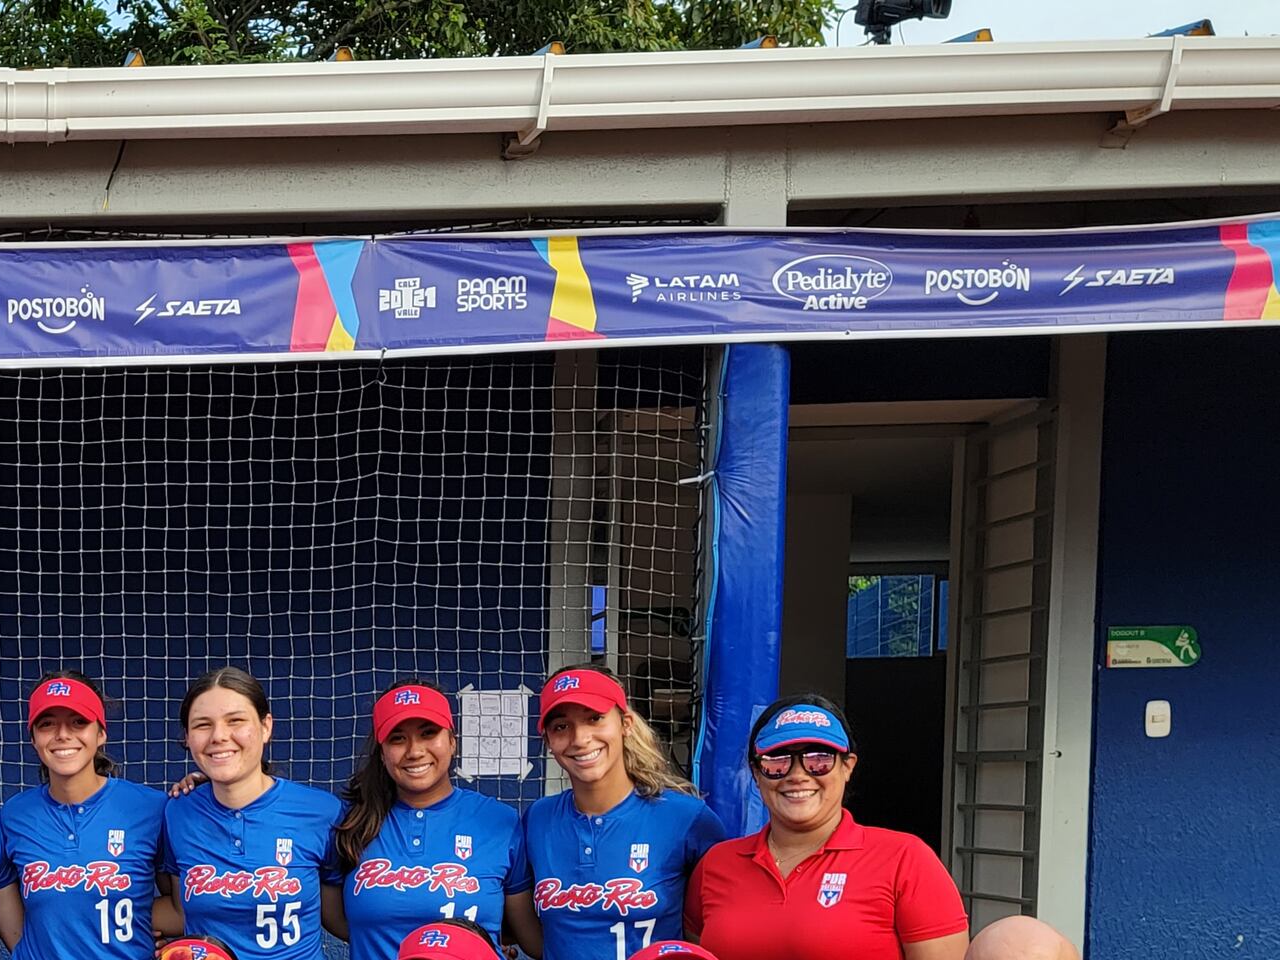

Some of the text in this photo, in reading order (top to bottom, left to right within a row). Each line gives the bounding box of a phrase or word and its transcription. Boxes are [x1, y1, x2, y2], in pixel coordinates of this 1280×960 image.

[457, 275, 526, 295] PANAM
[655, 273, 740, 288] LATAM
[786, 266, 890, 295] Pedialyte
[1087, 267, 1174, 287] SAETA
[456, 293, 528, 312] SPORTS
[656, 290, 741, 302] AIRLINES
[804, 292, 867, 310] Active
[157, 298, 241, 317] SAETA
[23, 861, 131, 901] Puerto Rico
[183, 864, 301, 902] Puerto Rico
[354, 859, 480, 898] Puerto Rico
[822, 873, 847, 885] PUR
[533, 878, 657, 915] Puerto Rico
[95, 898, 133, 944] 19
[255, 901, 301, 948] 55
